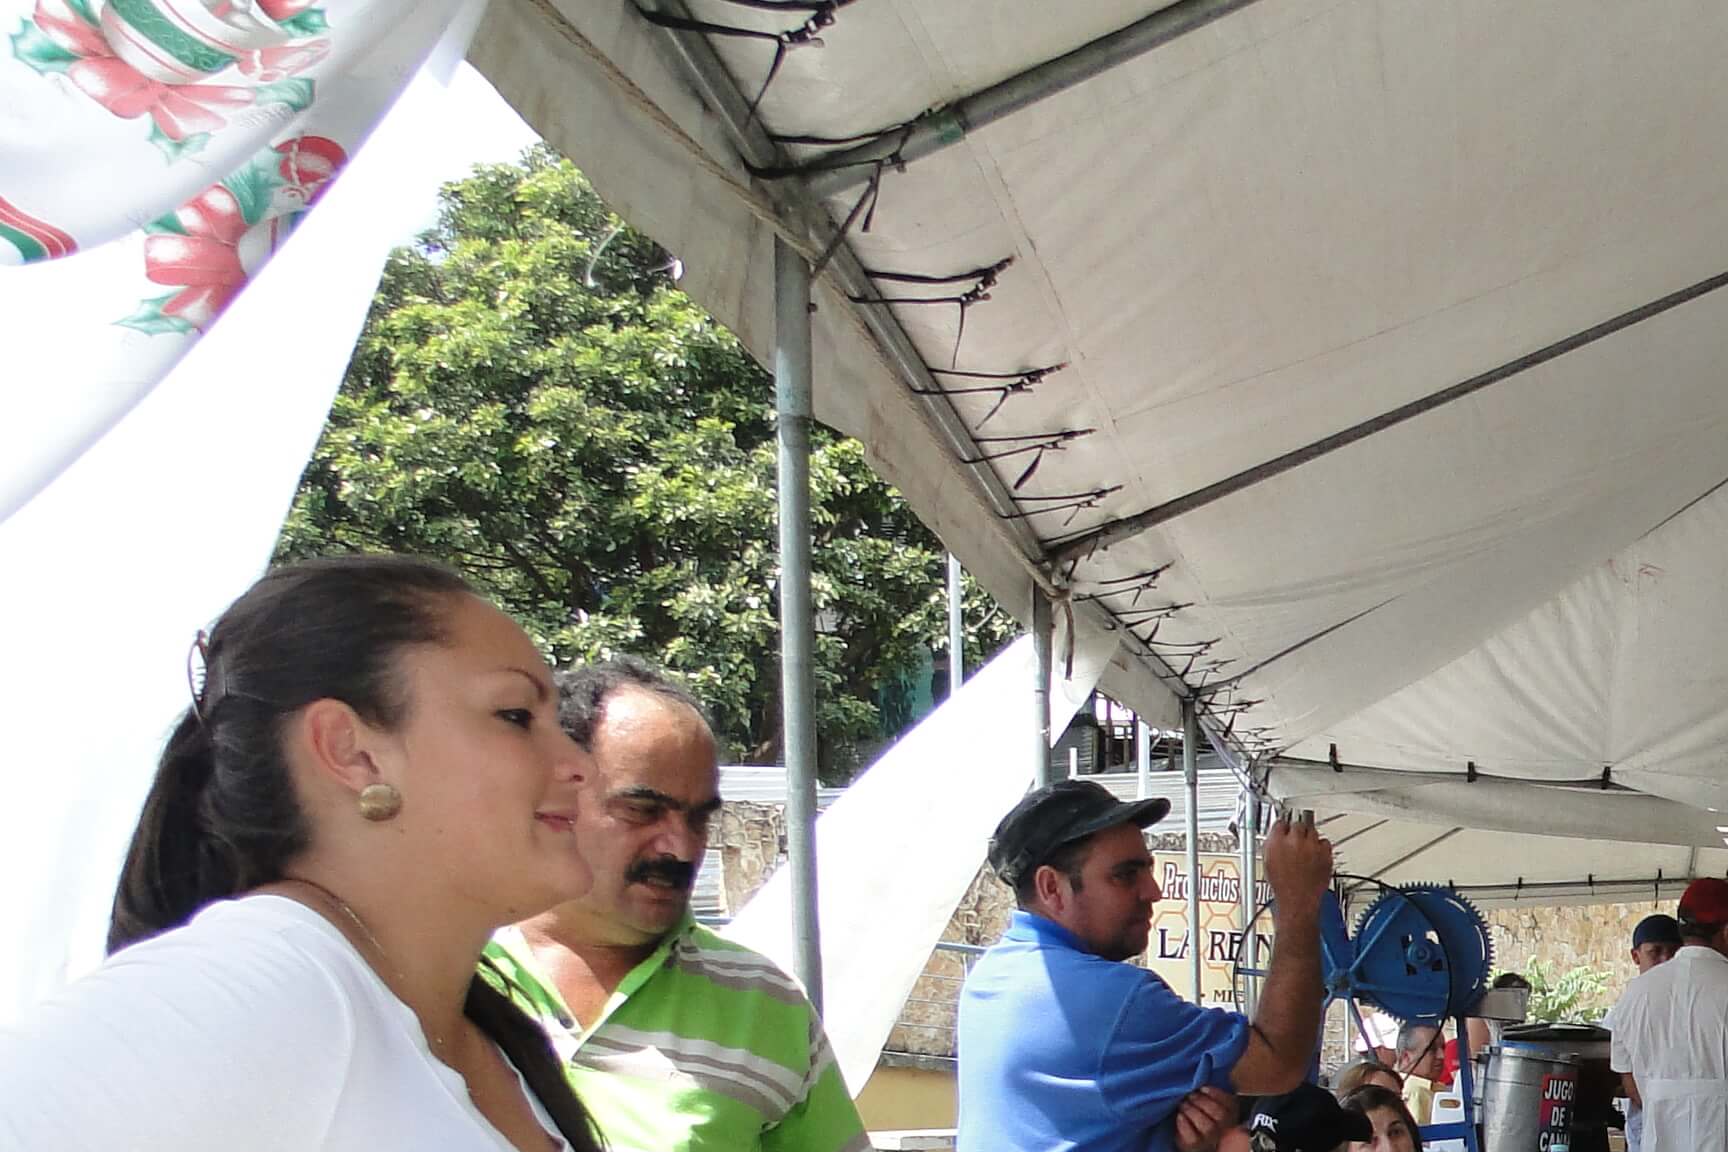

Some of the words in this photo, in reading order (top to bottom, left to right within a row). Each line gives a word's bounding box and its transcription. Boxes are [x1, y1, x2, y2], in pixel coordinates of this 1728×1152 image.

[1161, 862, 1240, 902] Prouctos
[1544, 1079, 1575, 1100] JUGO
[1551, 1106, 1566, 1127] DE
